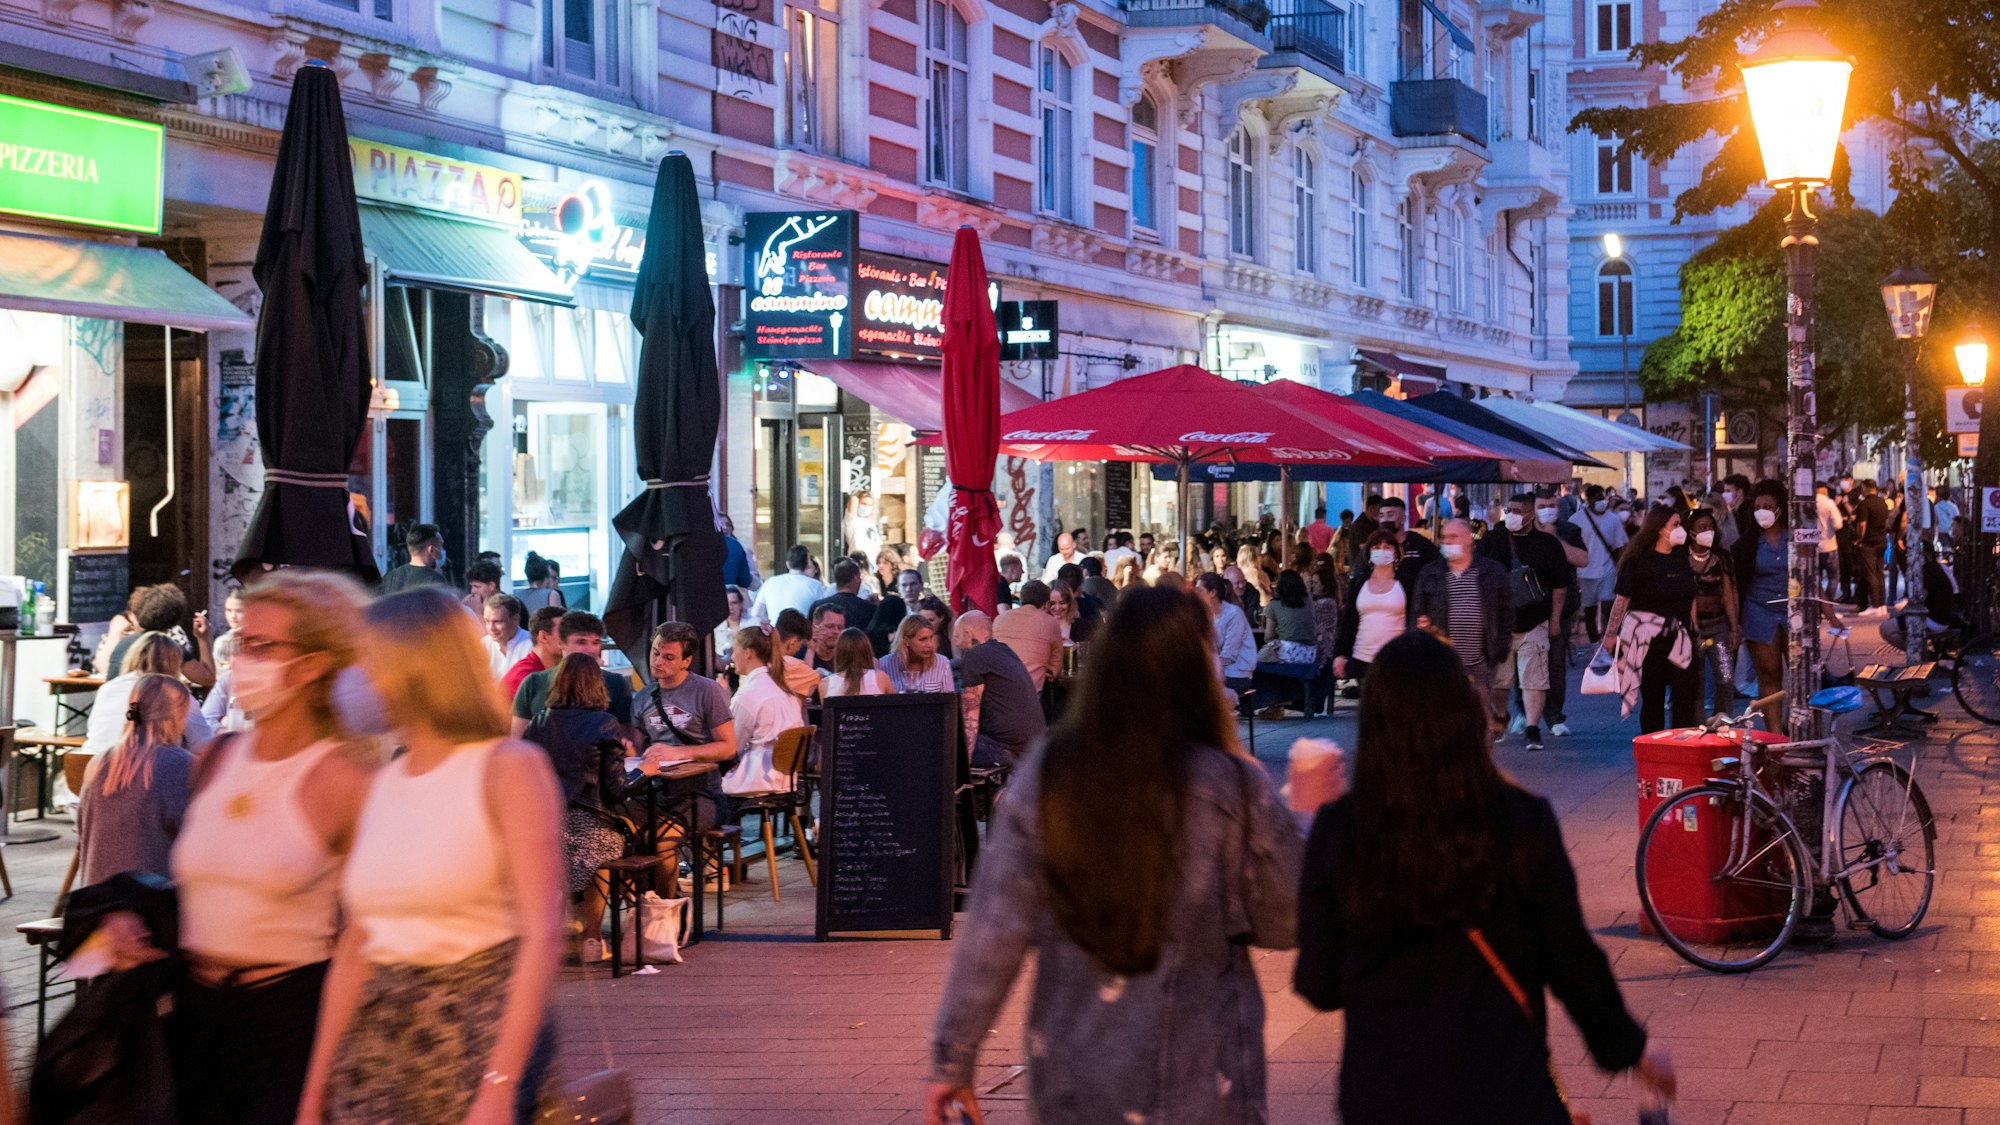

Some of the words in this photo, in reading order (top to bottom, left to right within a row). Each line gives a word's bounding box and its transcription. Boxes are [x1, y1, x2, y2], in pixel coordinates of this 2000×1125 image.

[0, 142, 100, 184] PIZZERIA
[369, 148, 491, 214] PIAZZA
[792, 250, 843, 259] Ristorante
[808, 261, 827, 271] Bar
[798, 274, 837, 283] Pizzeria
[908, 272, 928, 288] Bar
[751, 291, 848, 313] cammino
[756, 325, 823, 335] Hausgemachte
[757, 335, 823, 345] Steinofenpizza
